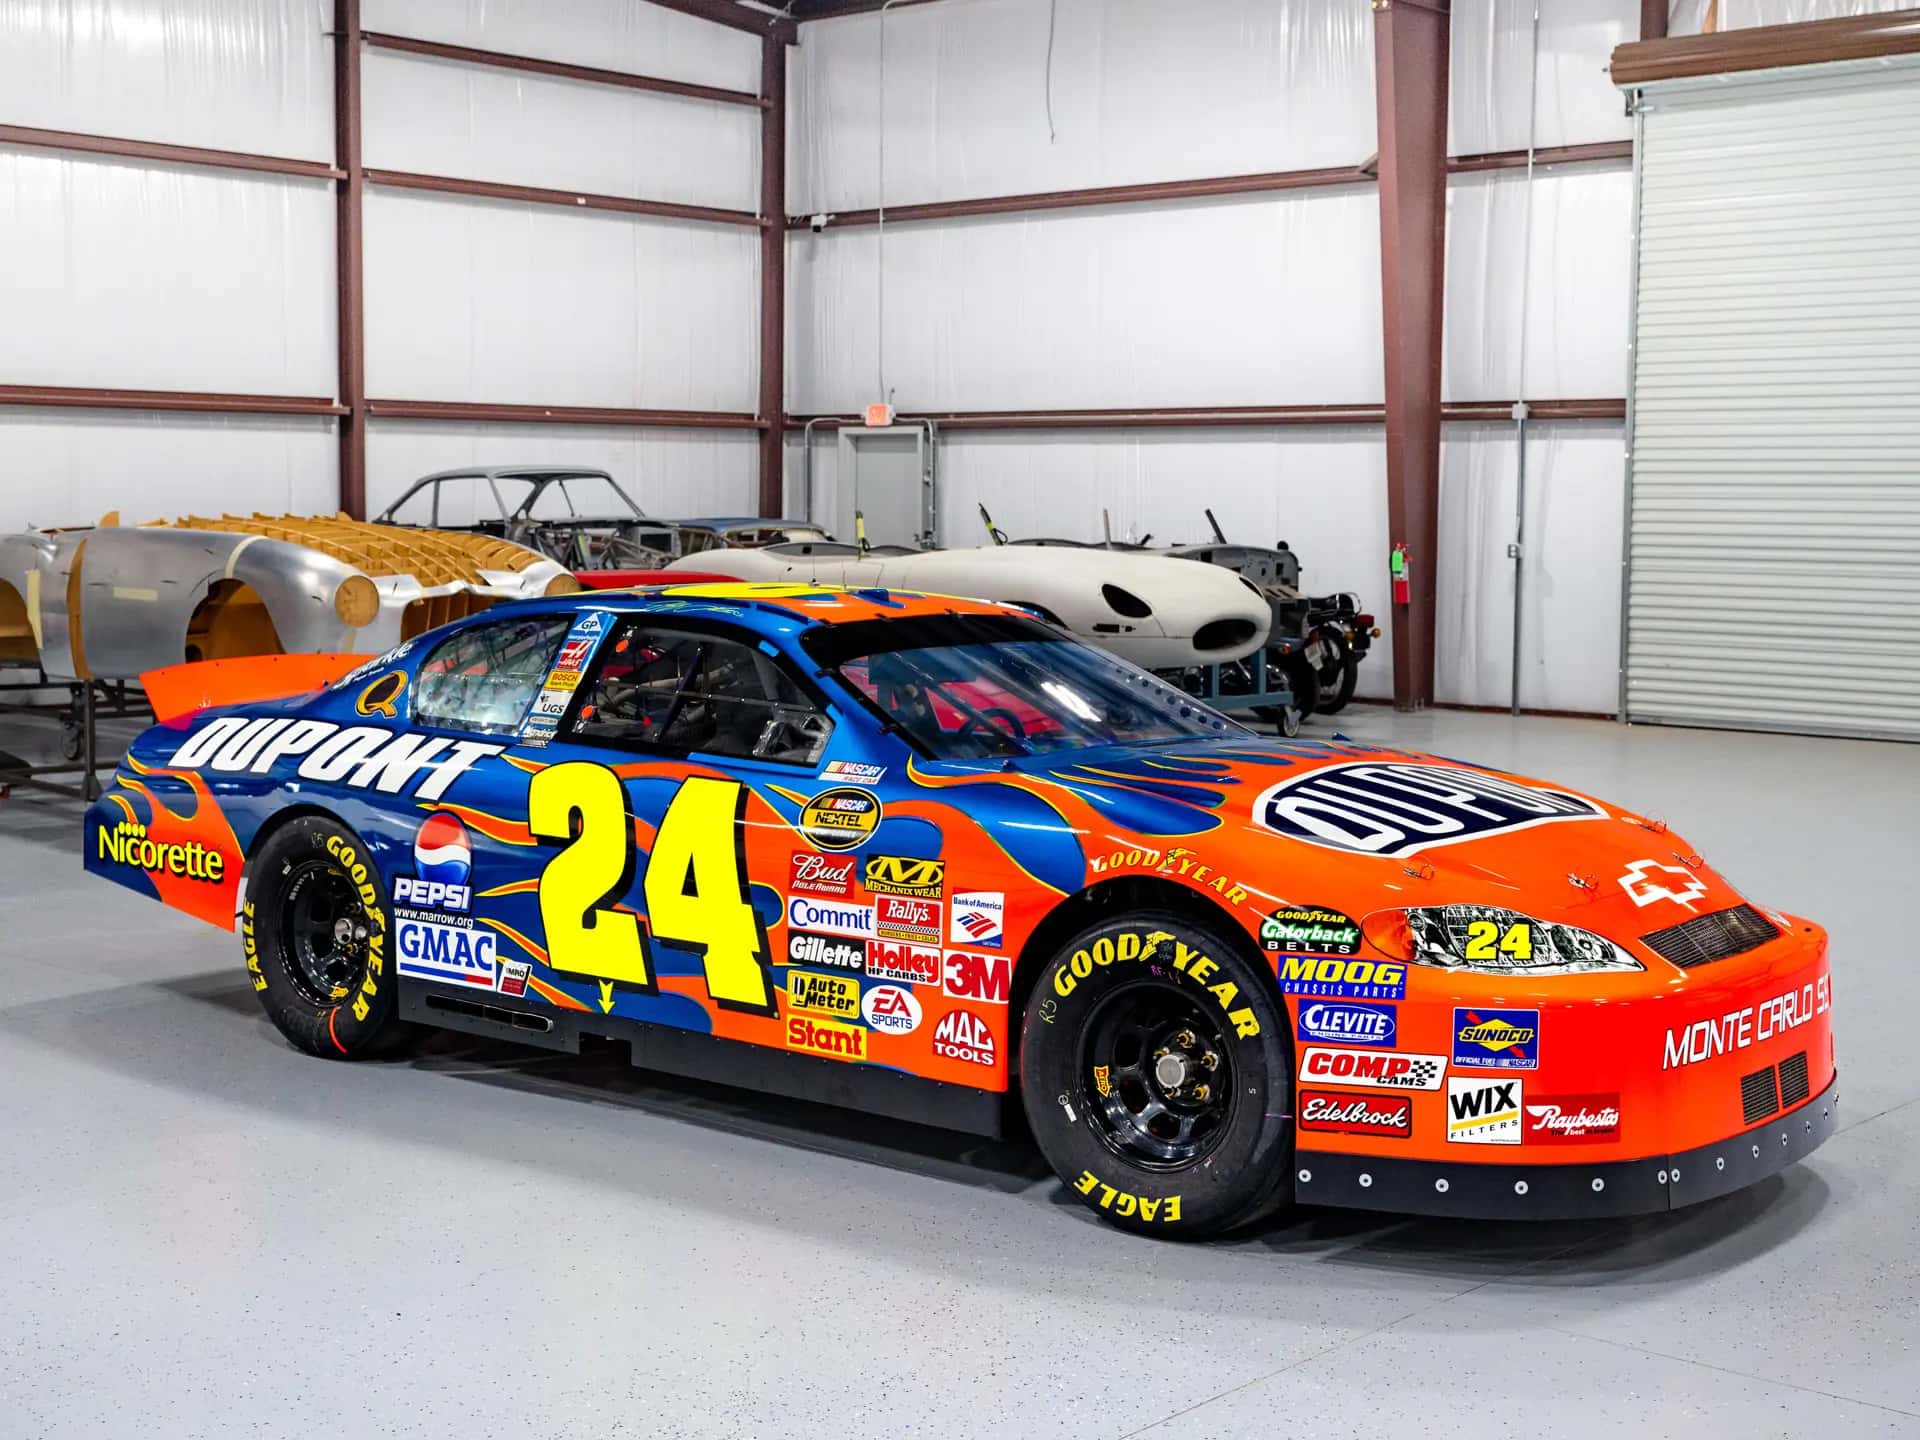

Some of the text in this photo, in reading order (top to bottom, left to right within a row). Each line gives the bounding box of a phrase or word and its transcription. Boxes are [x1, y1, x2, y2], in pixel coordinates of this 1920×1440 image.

[581, 621, 598, 630] GP
[553, 672, 578, 681] BOSCH
[355, 670, 408, 718] Q
[542, 703, 565, 714] UGS
[168, 718, 506, 800] DUPONT
[844, 762, 881, 777] NASCAR
[833, 798, 868, 812] NASCAR
[815, 811, 862, 827] NEXTEL
[98, 822, 225, 882] Nicorette
[793, 854, 854, 881] Bud
[1091, 848, 1248, 906] GOODYEAR
[394, 877, 471, 910] PEPSI
[528, 760, 770, 1008] 24
[864, 879, 942, 898] MECHANIX WEAR
[790, 899, 872, 930] Commit
[886, 900, 929, 924] Rally's
[953, 896, 969, 906] Bank
[976, 900, 1002, 910] America
[326, 836, 387, 1022] GOODYEAR
[394, 907, 474, 930] www.marrow.org
[1276, 911, 1346, 924] GOODYEAR
[243, 896, 269, 992] EAGLE
[1262, 921, 1356, 944] Gatorback
[1466, 920, 1532, 960] 24
[400, 924, 493, 972] GMAC
[790, 936, 863, 968] Gillette
[1267, 941, 1350, 954] BELTS
[868, 942, 939, 982] Holley
[868, 966, 926, 982] HP CARBS
[1280, 958, 1405, 985] MOOG
[808, 978, 847, 996] Auto
[945, 954, 1011, 1002] 3M
[1053, 931, 1261, 1041] GOODYEAR
[1285, 982, 1397, 998] CHASSIS PARTS
[806, 992, 855, 1011] Meter
[872, 988, 912, 1017] EA
[871, 1014, 913, 1030] SPORTS
[934, 1011, 993, 1050] MAC
[1305, 1004, 1388, 1034] CLEVITE
[1663, 1006, 1753, 1070] MONTE
[1757, 984, 1813, 1041] CARLO
[789, 1018, 862, 1055] Stant
[1461, 1028, 1532, 1042] SUNOCO
[934, 1043, 994, 1066] TOOLS
[1307, 1052, 1411, 1078] COMP
[1376, 1075, 1428, 1087] CAMS
[1302, 1097, 1409, 1127] Edelbrock
[1450, 1082, 1517, 1120] WIX
[1451, 1120, 1519, 1139] FILTERS
[1525, 1105, 1619, 1135] Raybestos
[1074, 1170, 1182, 1223] EAGLE
